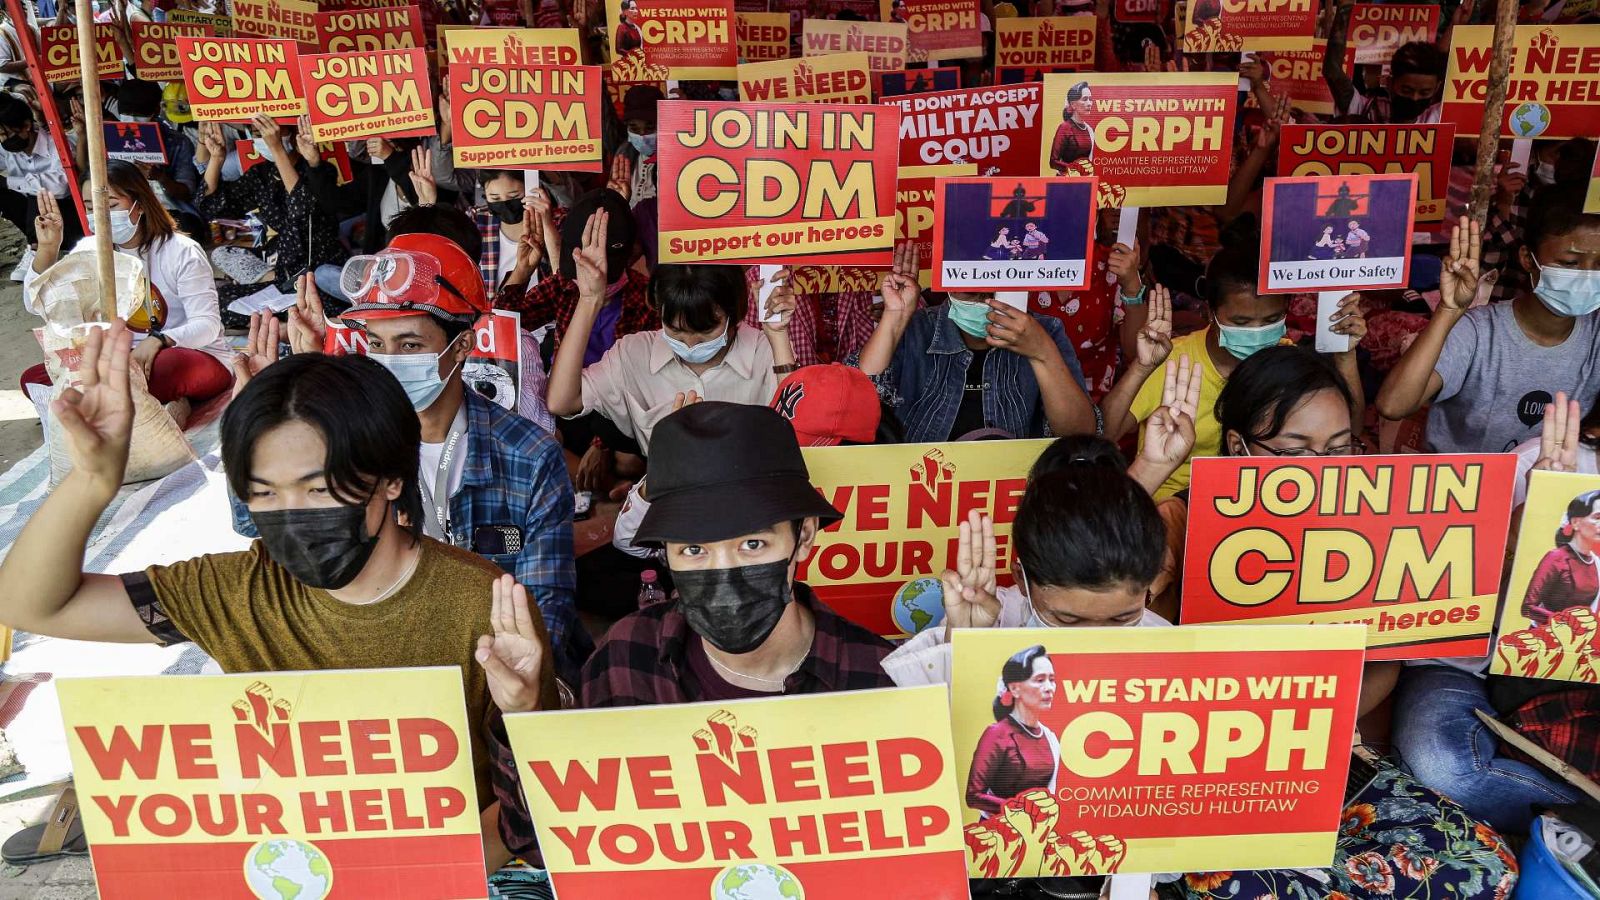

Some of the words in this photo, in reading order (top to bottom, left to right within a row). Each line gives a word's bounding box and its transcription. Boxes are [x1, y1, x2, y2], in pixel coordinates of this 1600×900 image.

[234, 2, 264, 18] WE
[268, 7, 314, 28] NEED
[640, 8, 658, 18] WE
[659, 8, 696, 18] STAND
[698, 8, 728, 18] WITH
[907, 5, 922, 14] WE
[922, 3, 950, 12] STAND
[952, 1, 975, 10] WITH
[1355, 7, 1401, 22] JOIN
[1410, 8, 1430, 22] IN
[139, 25, 180, 40] JOIN
[187, 26, 206, 38] IN
[172, 14, 212, 24] MILITARY
[216, 18, 232, 28] COU
[236, 18, 277, 36] YOUR
[279, 26, 316, 41] HELP
[324, 12, 380, 32] JOIN
[385, 10, 410, 28] IN
[641, 20, 729, 44] CRPH
[908, 11, 976, 33] CRPH
[48, 28, 78, 42] JOI
[96, 26, 114, 38] IN
[328, 30, 416, 53] CDM
[736, 26, 788, 42] NEED
[806, 33, 841, 50] WE
[846, 34, 904, 53] NEED
[999, 31, 1033, 48] WE
[1039, 30, 1094, 48] NEED
[1352, 25, 1428, 48] CDM
[47, 43, 116, 66] CM
[140, 42, 178, 65] CD
[188, 42, 252, 64] JOIN
[257, 43, 286, 64] IN
[452, 46, 498, 64] WE
[504, 46, 578, 66] NEED
[746, 46, 788, 58] HELP
[1000, 52, 1046, 65] YOUR
[1050, 50, 1092, 64] HELP
[1290, 51, 1322, 60] STAND
[1524, 47, 1600, 74] NEE
[46, 70, 78, 80] Support
[98, 62, 121, 72] eroes
[140, 70, 172, 78] Support
[310, 56, 378, 80] JOIN
[384, 54, 414, 76] IN
[1271, 58, 1330, 82] CRP
[192, 66, 296, 100] CDM
[461, 68, 543, 94] JOIN
[551, 70, 585, 96] IN
[742, 77, 788, 102] WE
[794, 70, 867, 98] NEED
[1547, 80, 1600, 102] HEL
[196, 106, 240, 118] Support
[242, 104, 261, 114] our
[261, 100, 301, 113] heroes
[315, 78, 424, 118] CDM
[914, 94, 967, 112] DON'T
[970, 88, 1039, 106] ACCEPT
[1096, 100, 1121, 112] WE
[1124, 98, 1179, 112] STAND
[1182, 98, 1226, 112] WITH
[318, 122, 366, 140] Support
[366, 119, 387, 130] our
[387, 112, 429, 128] heroes
[462, 98, 590, 140] CDM
[676, 108, 809, 150] JOIN
[822, 111, 876, 151] IN
[900, 104, 1040, 140] MILITARY
[1094, 116, 1224, 153] CRPH
[1293, 130, 1386, 156] JOIN
[1395, 129, 1436, 155] IN
[460, 146, 517, 164] Support
[519, 146, 542, 158] our
[545, 143, 595, 156] heroes
[920, 134, 1011, 164] COUP
[1094, 156, 1150, 166] COMMITTEE
[1152, 156, 1218, 166] REPRESENTING
[1102, 166, 1163, 176] PYIDAUNGSU
[1165, 165, 1208, 174] HLUTTAW
[676, 156, 879, 220] CDM
[669, 231, 762, 256] Support
[766, 229, 804, 247] our
[808, 224, 884, 244] heroes
[946, 267, 968, 280] We
[972, 268, 1002, 280] Lost
[1006, 267, 1034, 280] Our
[1037, 266, 1079, 282] Safety
[1272, 269, 1293, 282] We
[1297, 268, 1324, 280] Lost
[1329, 266, 1356, 279] Our
[1358, 265, 1398, 280] Safety
[440, 430, 460, 472] Supreme
[1214, 464, 1394, 517] JOIN
[1407, 464, 1484, 514] IN
[907, 478, 1027, 529] NEE
[797, 540, 934, 582] YOUR
[1208, 524, 1476, 606] CDM
[1378, 604, 1480, 632] heroes
[1062, 680, 1119, 704] WE
[1124, 677, 1240, 702] STAND
[1246, 675, 1338, 700] WITH
[74, 724, 219, 780] WE
[234, 717, 460, 779] NEED
[1059, 708, 1334, 779] CRPH
[527, 755, 682, 813] WE
[696, 736, 944, 808] NEED
[1058, 786, 1176, 802] COMMITTEE
[1181, 779, 1320, 798] REPRESENTING
[91, 794, 288, 838] YOUR
[300, 786, 467, 835] HELP
[1078, 802, 1204, 819] PYIDAUNGSU
[1208, 798, 1298, 816] HLUTTAW
[548, 820, 758, 866] YOUR
[769, 804, 950, 858] HELP
